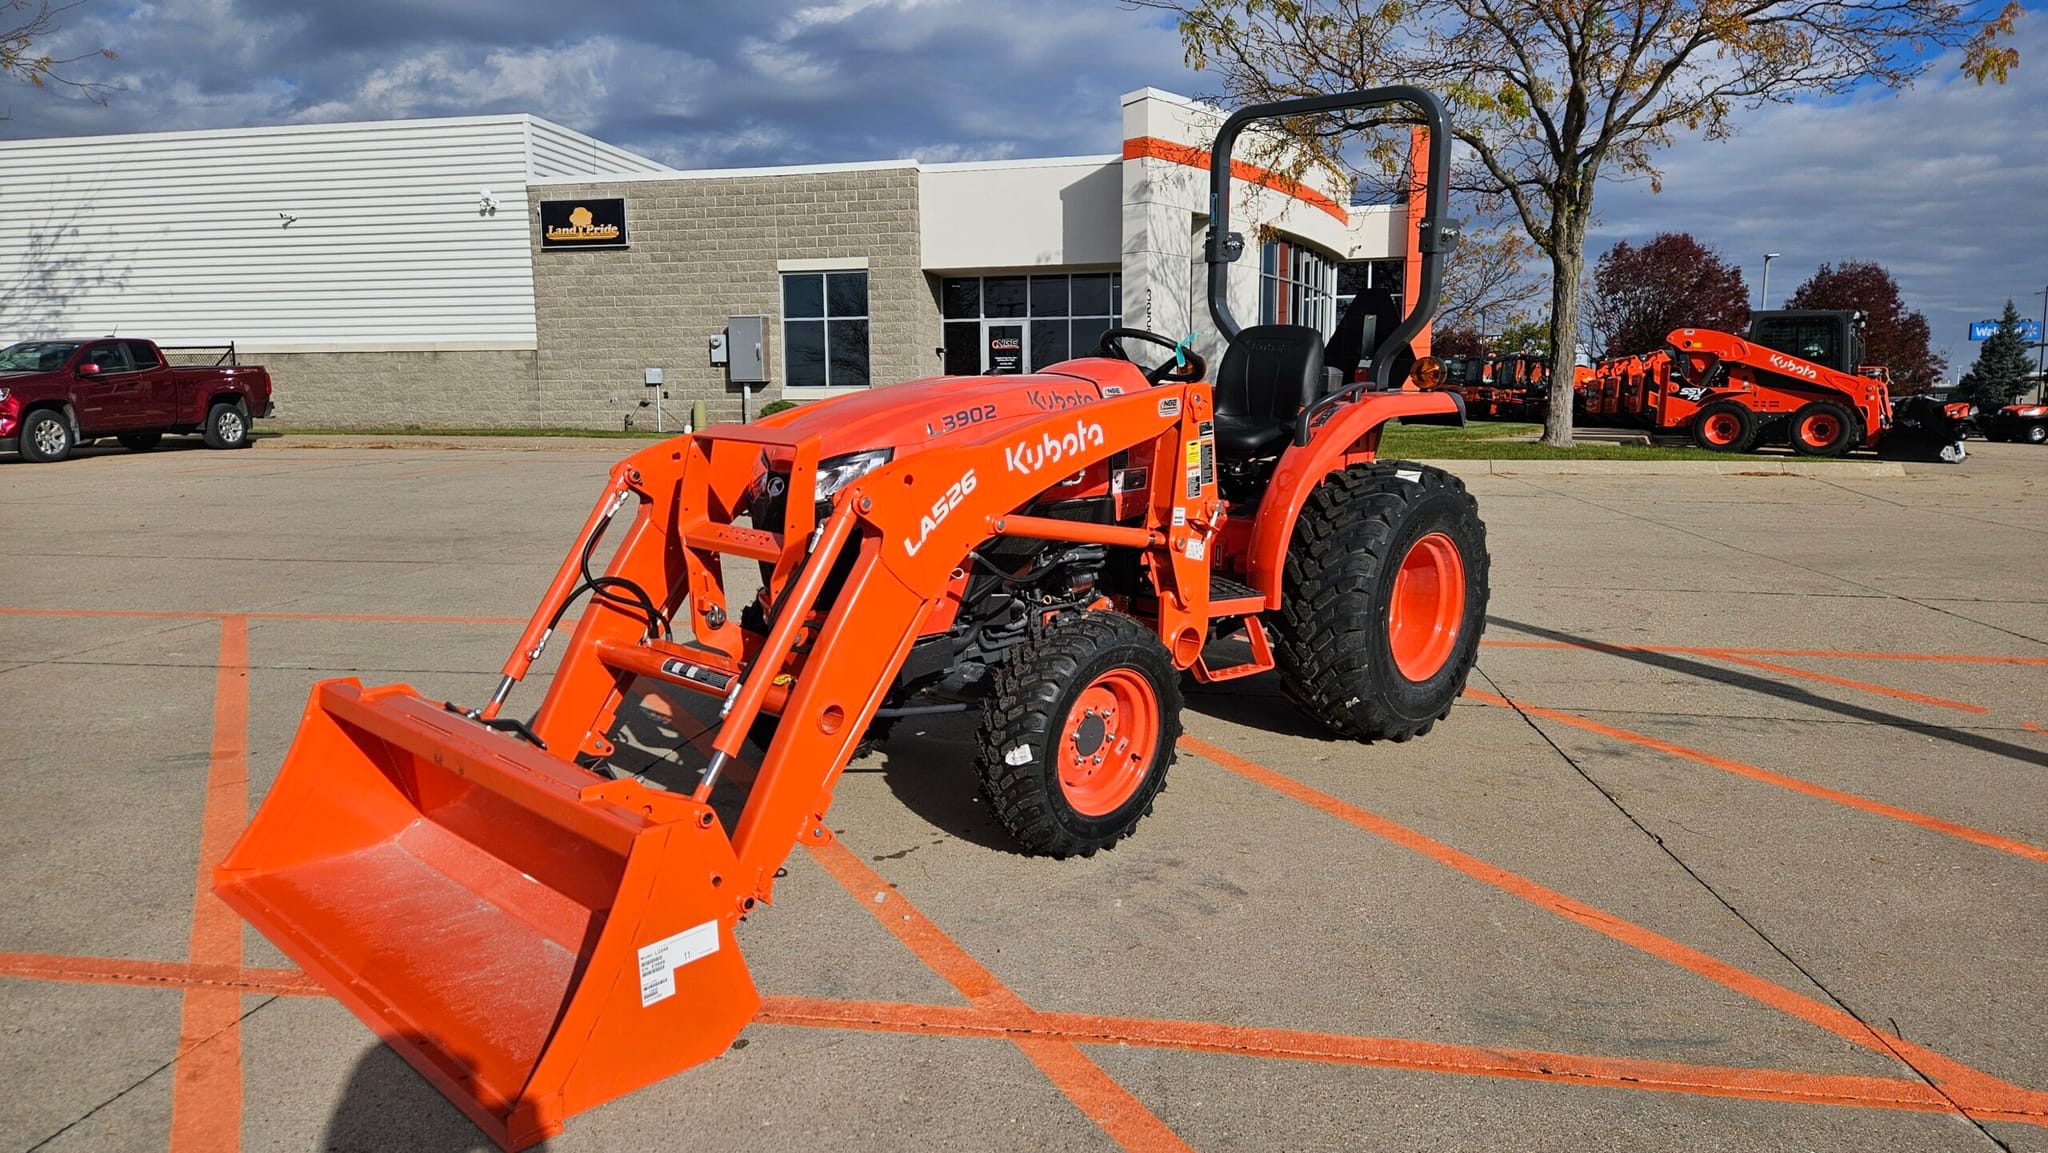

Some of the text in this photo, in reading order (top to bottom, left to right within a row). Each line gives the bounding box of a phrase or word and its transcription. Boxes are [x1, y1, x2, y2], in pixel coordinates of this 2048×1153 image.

[548, 223, 618, 235] Land Pride
[1770, 353, 1817, 379] Kubota
[927, 405, 998, 438] L3902
[1005, 419, 1104, 475] Kubota
[903, 468, 977, 557] LA526
